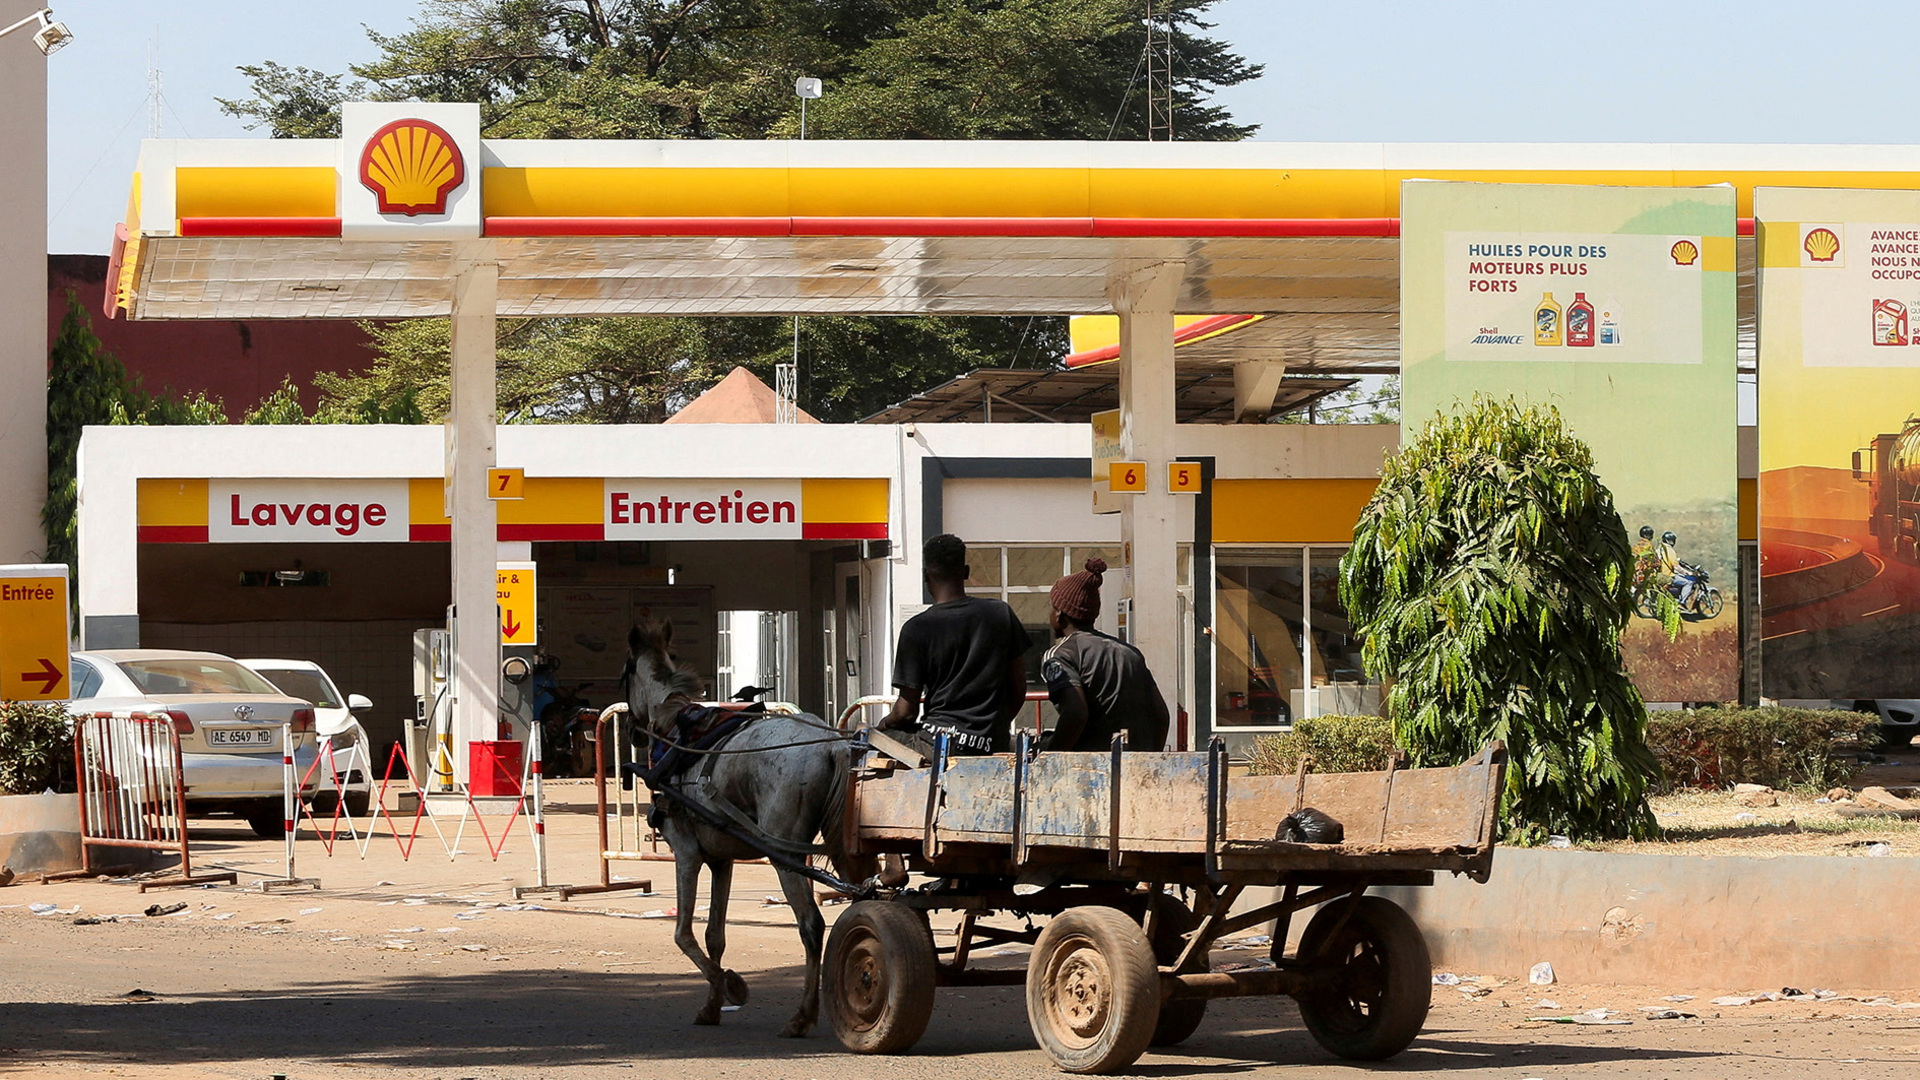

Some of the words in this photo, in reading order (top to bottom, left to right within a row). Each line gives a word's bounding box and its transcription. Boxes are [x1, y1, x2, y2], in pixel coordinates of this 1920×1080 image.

[1871, 231, 1920, 240] AVANCE
[1469, 244, 1523, 257] HUILES
[1528, 245, 1573, 258] POUR
[1578, 246, 1607, 259] DES
[1871, 256, 1907, 267] NOUS
[1469, 262, 1545, 275] MOTEURS
[1550, 263, 1588, 276] PLUS
[1469, 280, 1518, 293] FORTS
[1479, 327, 1499, 335] Shell
[1470, 335, 1525, 345] ADVANCE
[497, 474, 511, 491] 7
[1125, 469, 1137, 485] 6
[1178, 470, 1189, 486] 5
[610, 489, 796, 524] Entretien
[230, 493, 388, 536] Lavage
[497, 574, 508, 584] ir
[510, 574, 520, 584] &
[2, 584, 55, 601] Entrée
[497, 591, 511, 599] au
[213, 731, 226, 742] AE
[229, 731, 252, 742] 6549
[257, 730, 270, 742] MD
[959, 733, 993, 752] BUDS
